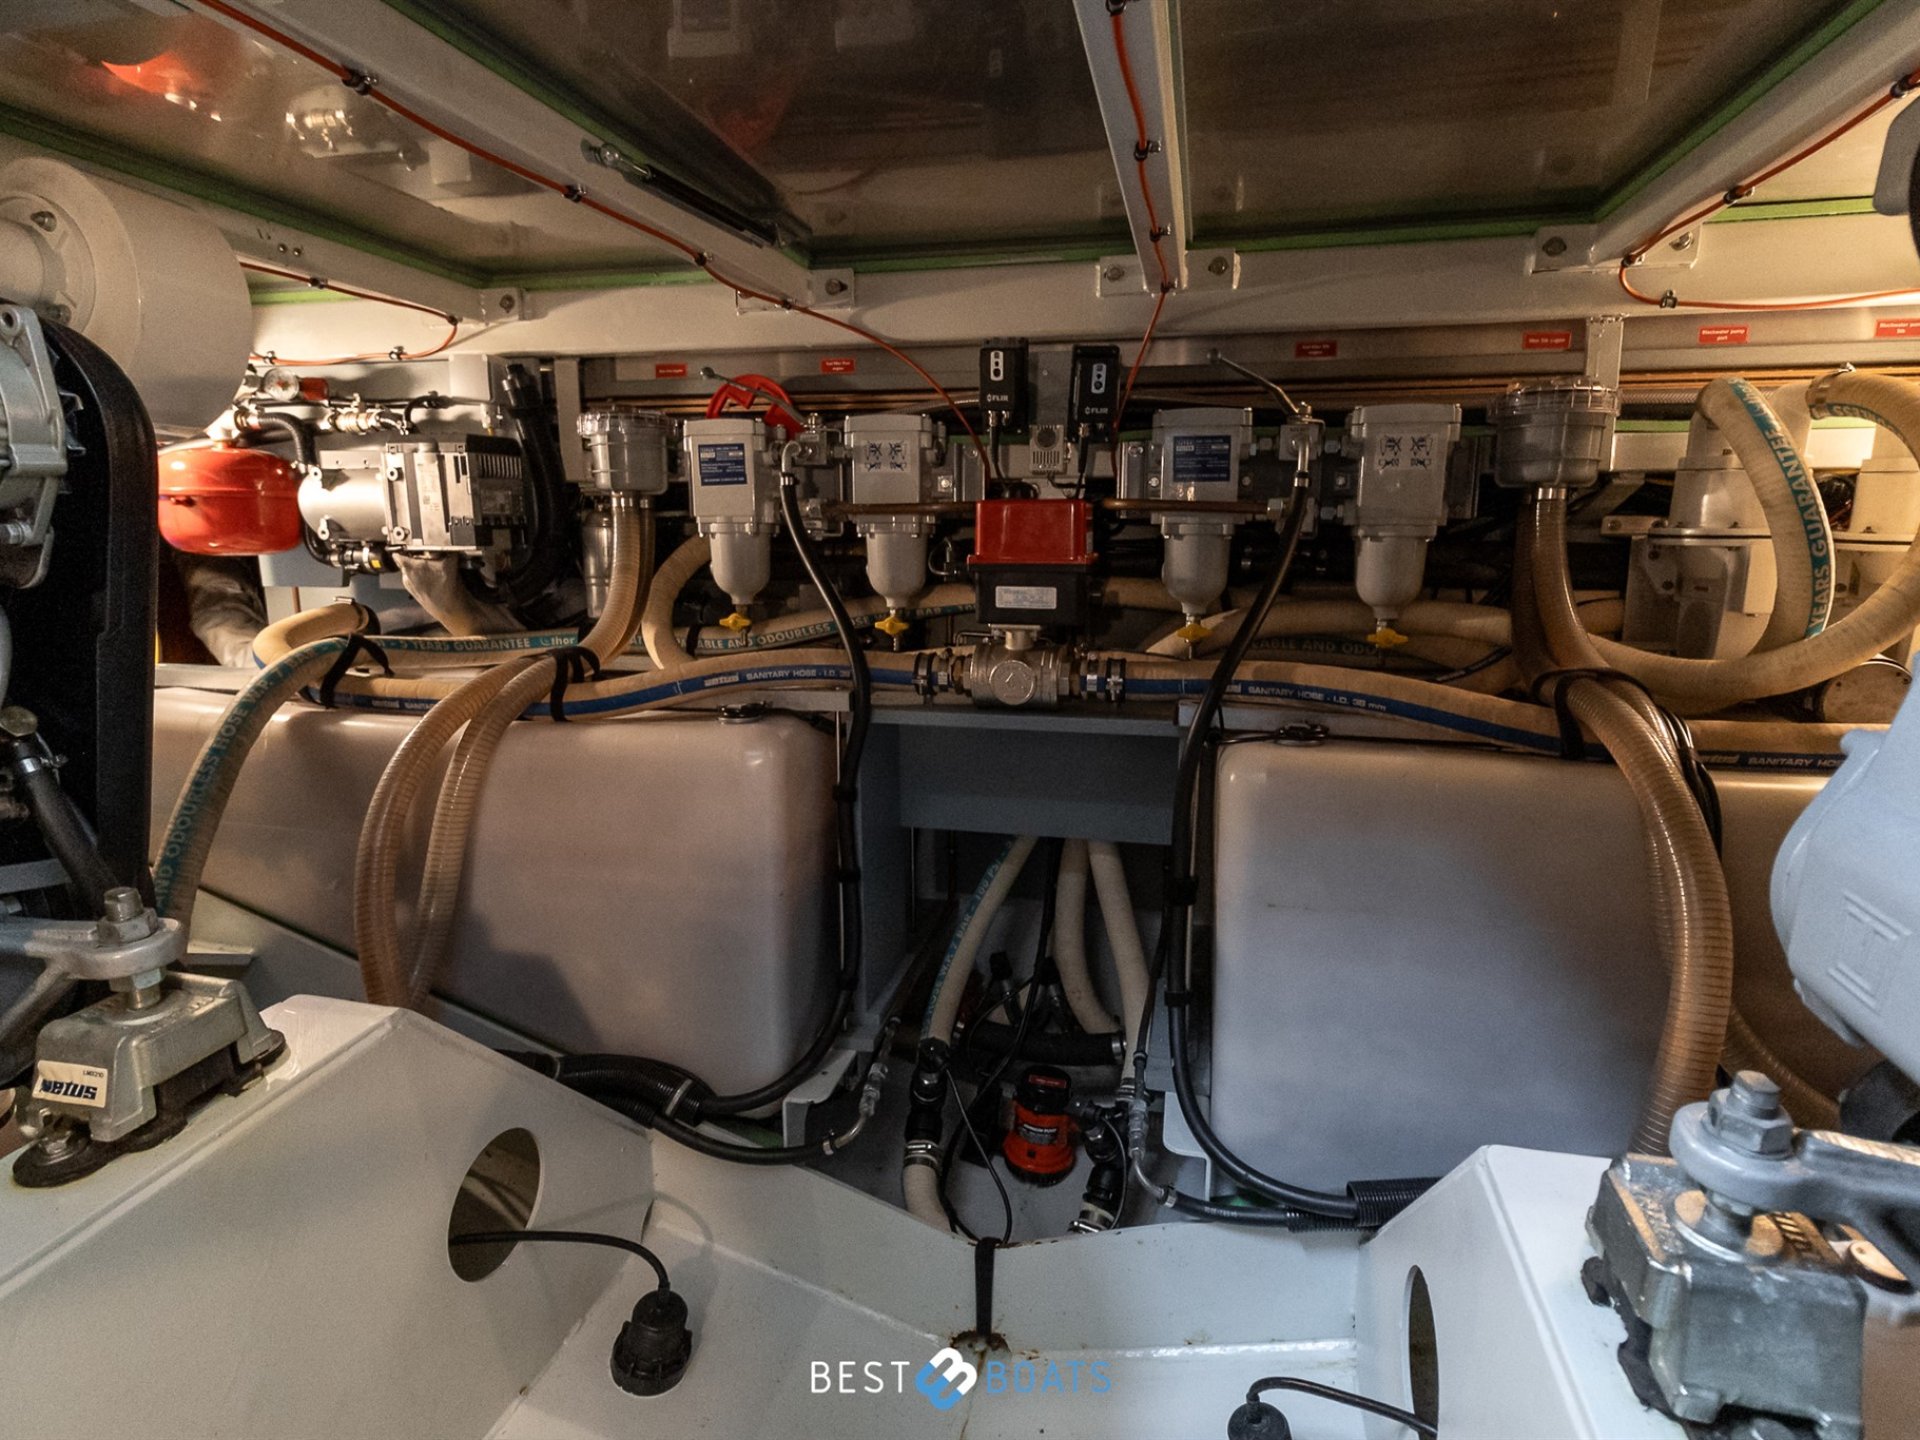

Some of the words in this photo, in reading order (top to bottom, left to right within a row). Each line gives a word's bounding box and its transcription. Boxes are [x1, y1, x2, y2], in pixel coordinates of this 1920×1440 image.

[1765, 429, 1828, 557] GUARANTEE
[1809, 564, 1830, 628] YEARS
[453, 638, 531, 651] GUARANTEE
[551, 635, 576, 646] thor
[757, 623, 831, 646] ODOURLESS
[746, 670, 790, 682] SANITARY
[793, 669, 817, 678] HOSE
[1248, 685, 1295, 698] SANITARY
[1297, 690, 1324, 702] HOSE
[1748, 756, 1812, 767] SANITARY
[1817, 759, 1841, 768] HOS
